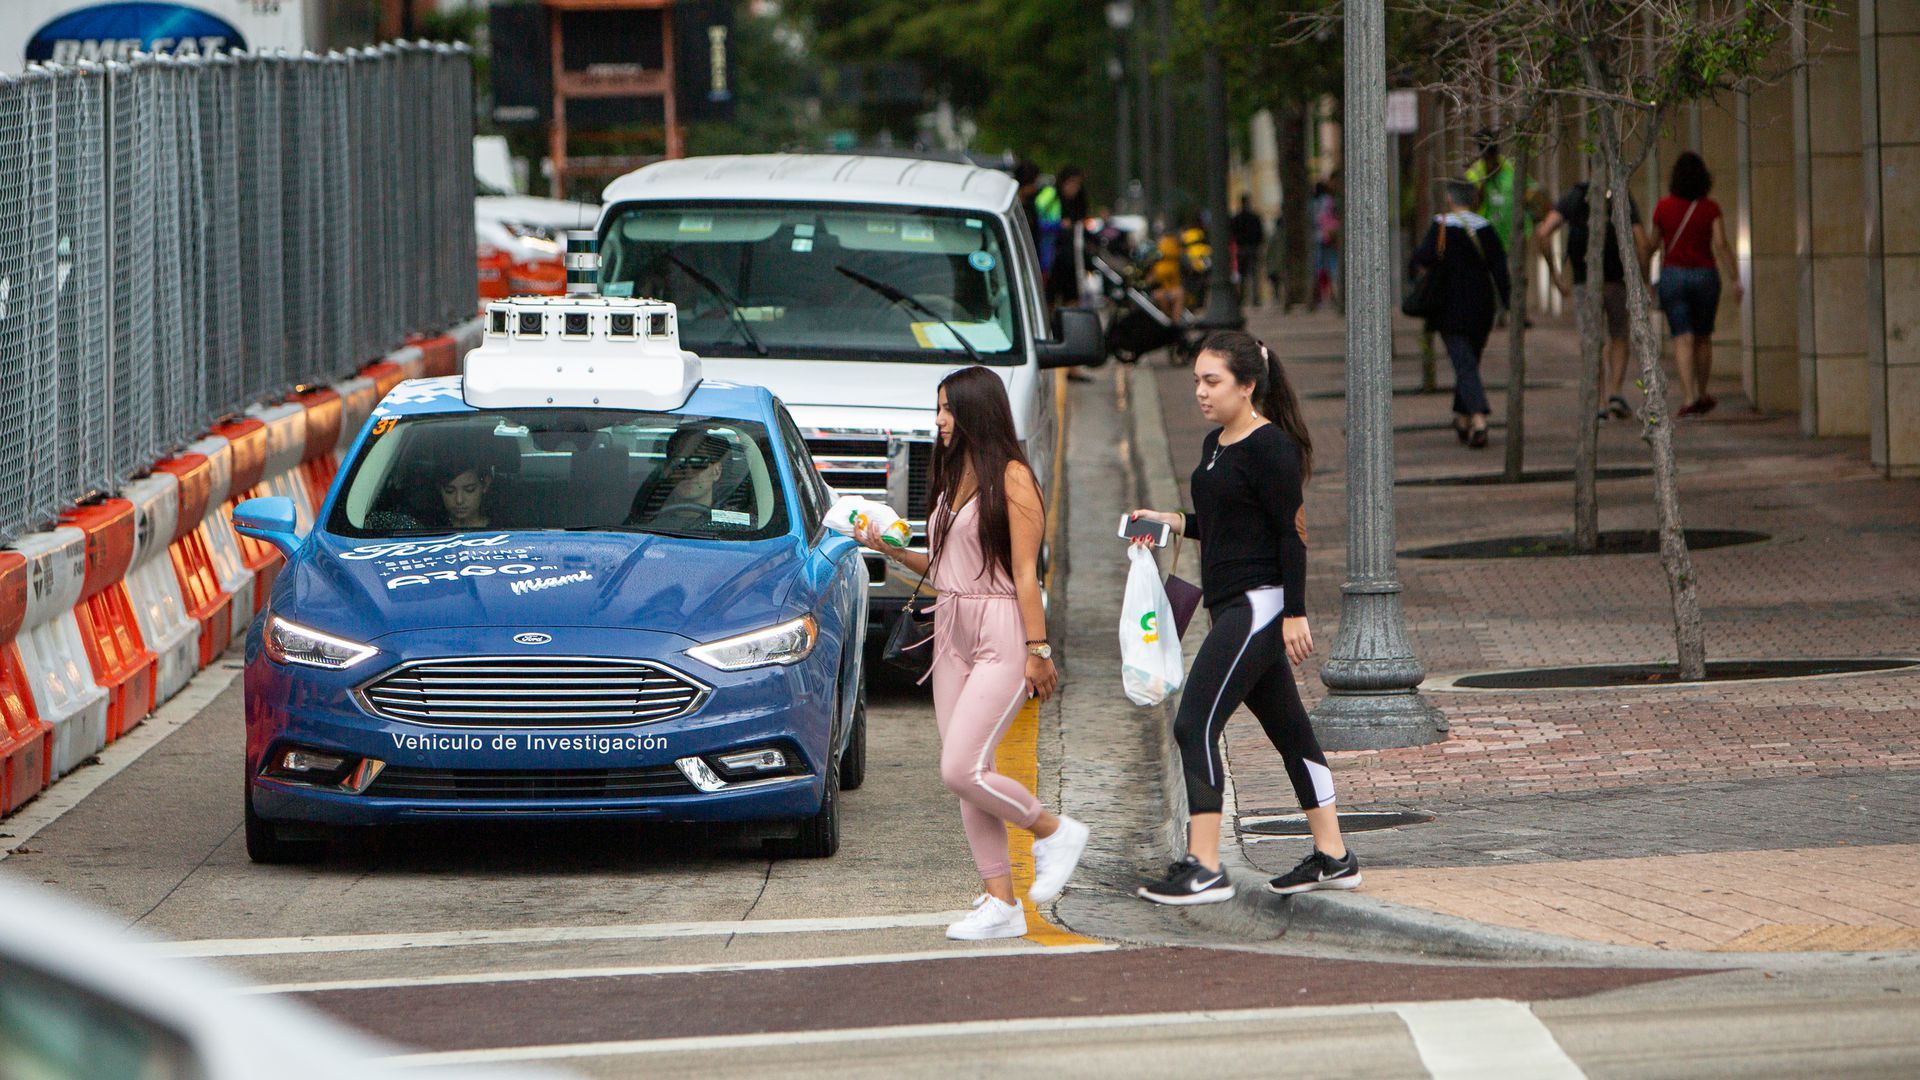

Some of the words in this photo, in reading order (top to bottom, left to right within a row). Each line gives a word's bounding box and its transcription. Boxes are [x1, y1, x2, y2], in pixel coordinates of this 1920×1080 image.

[372, 419, 399, 435] 31
[338, 534, 510, 560] Ford
[385, 548, 528, 567] SELF-DRIVING
[388, 561, 437, 572] TEST
[445, 553, 529, 564] VEHICLE
[386, 563, 536, 590] ARGO
[510, 570, 593, 595] Miami
[491, 734, 517, 750] de
[527, 733, 668, 753] Investigación
